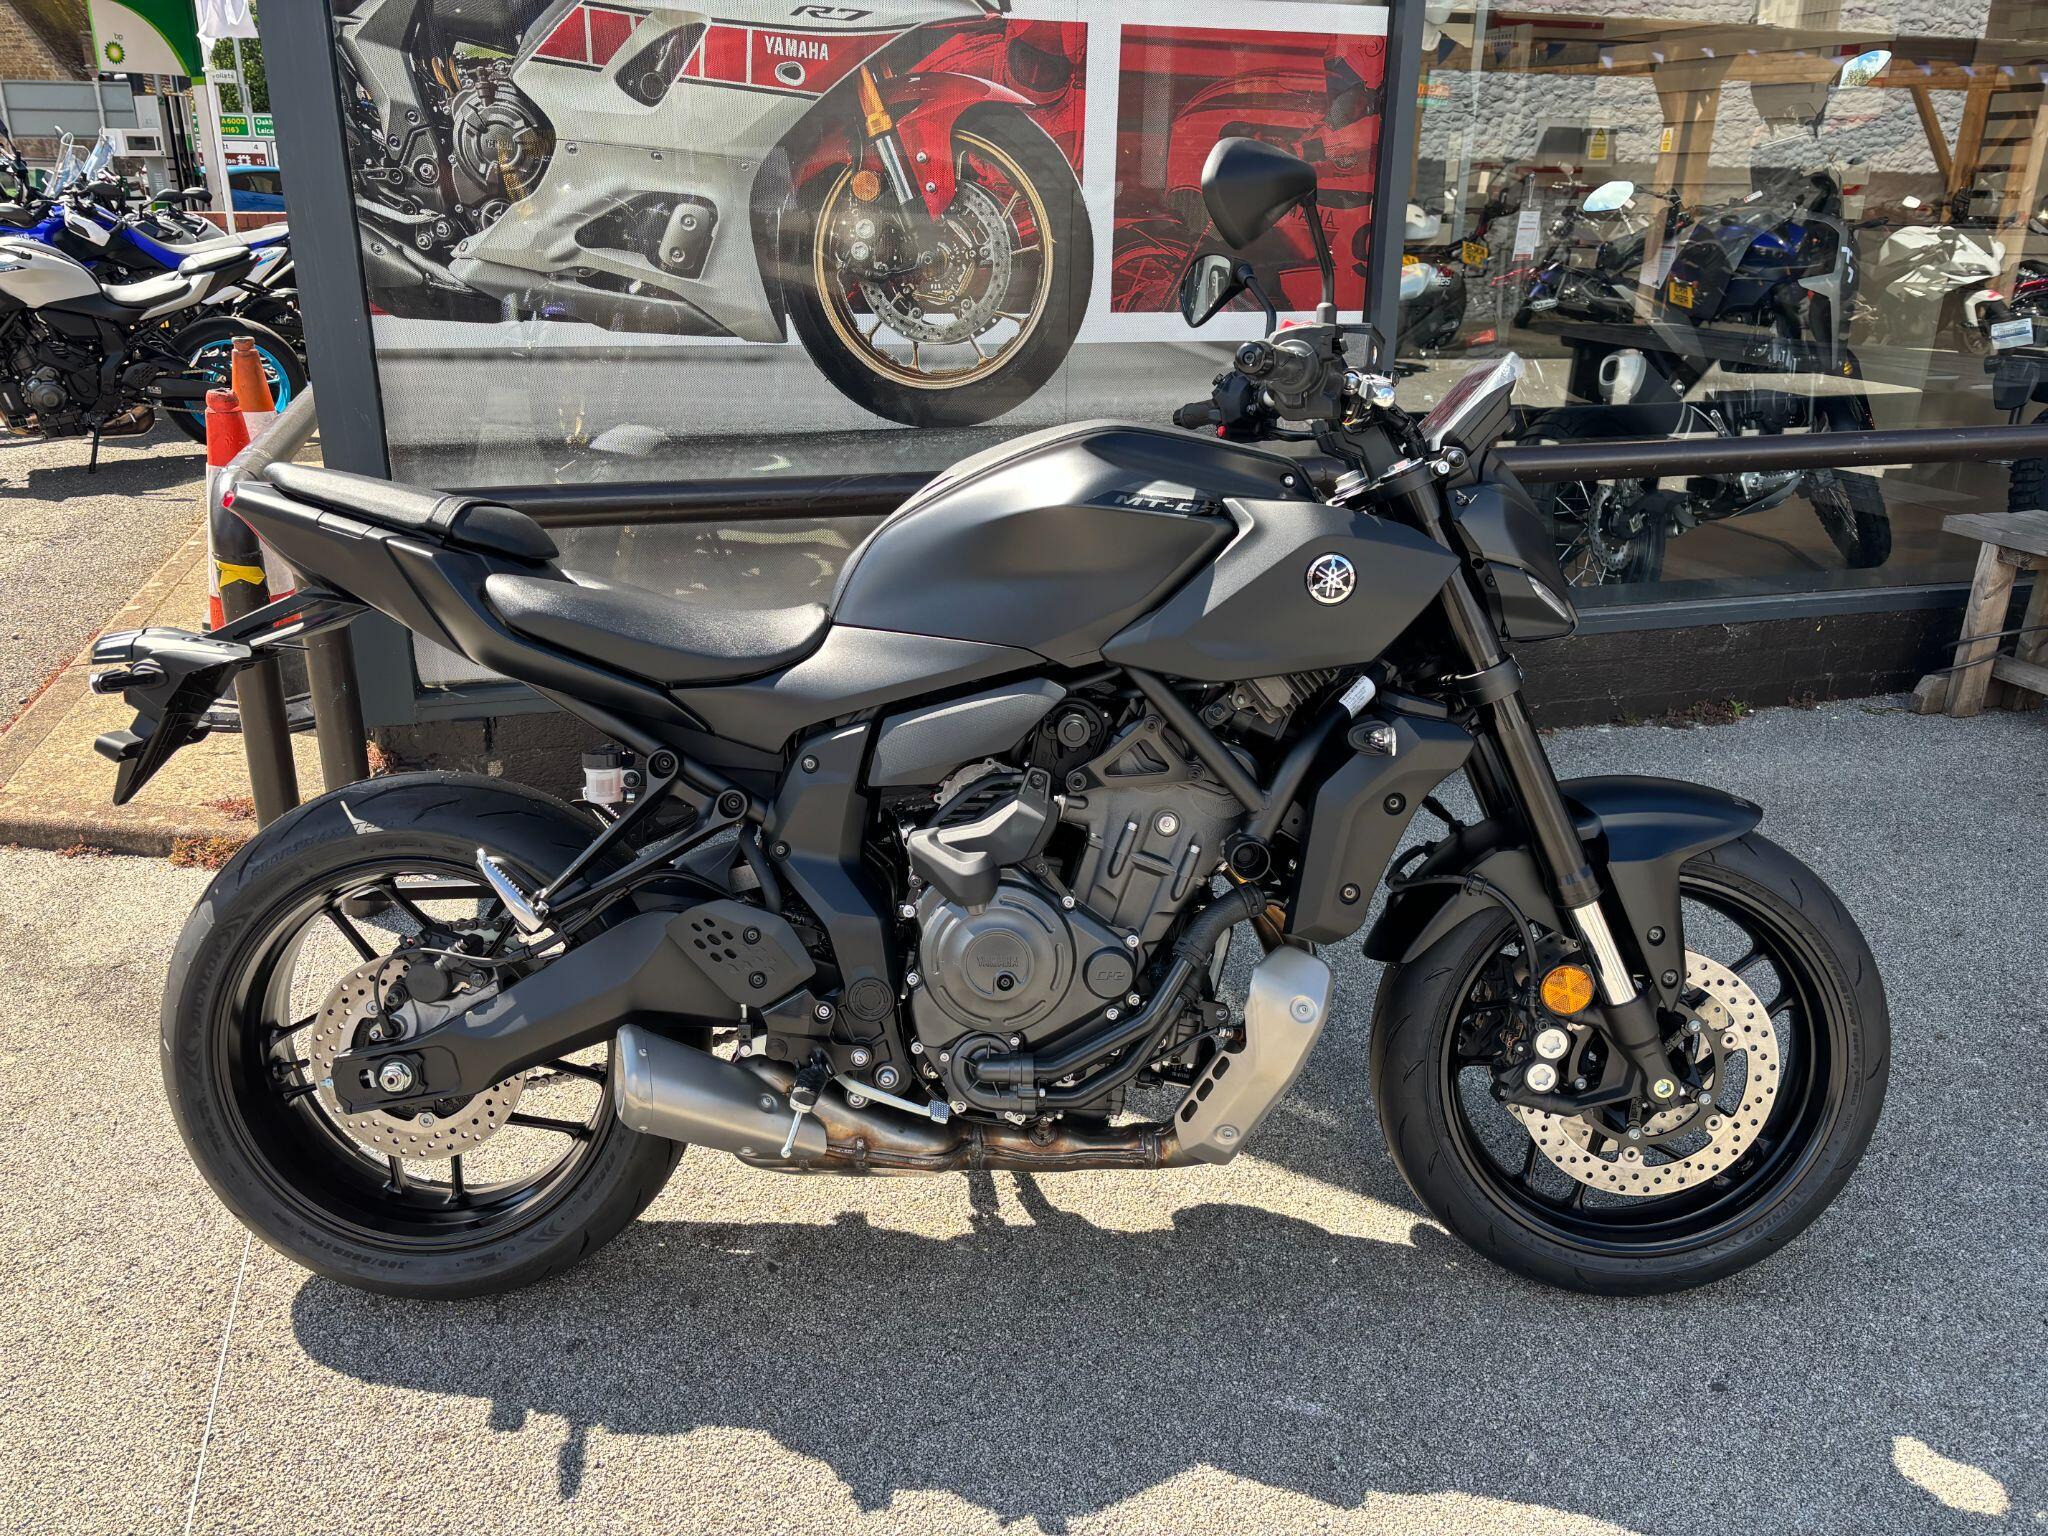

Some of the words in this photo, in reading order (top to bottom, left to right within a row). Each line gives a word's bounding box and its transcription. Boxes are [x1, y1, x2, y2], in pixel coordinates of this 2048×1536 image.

[790, 5, 874, 21] R7
[114, 33, 124, 41] bp
[764, 35, 829, 61] YAMAHA
